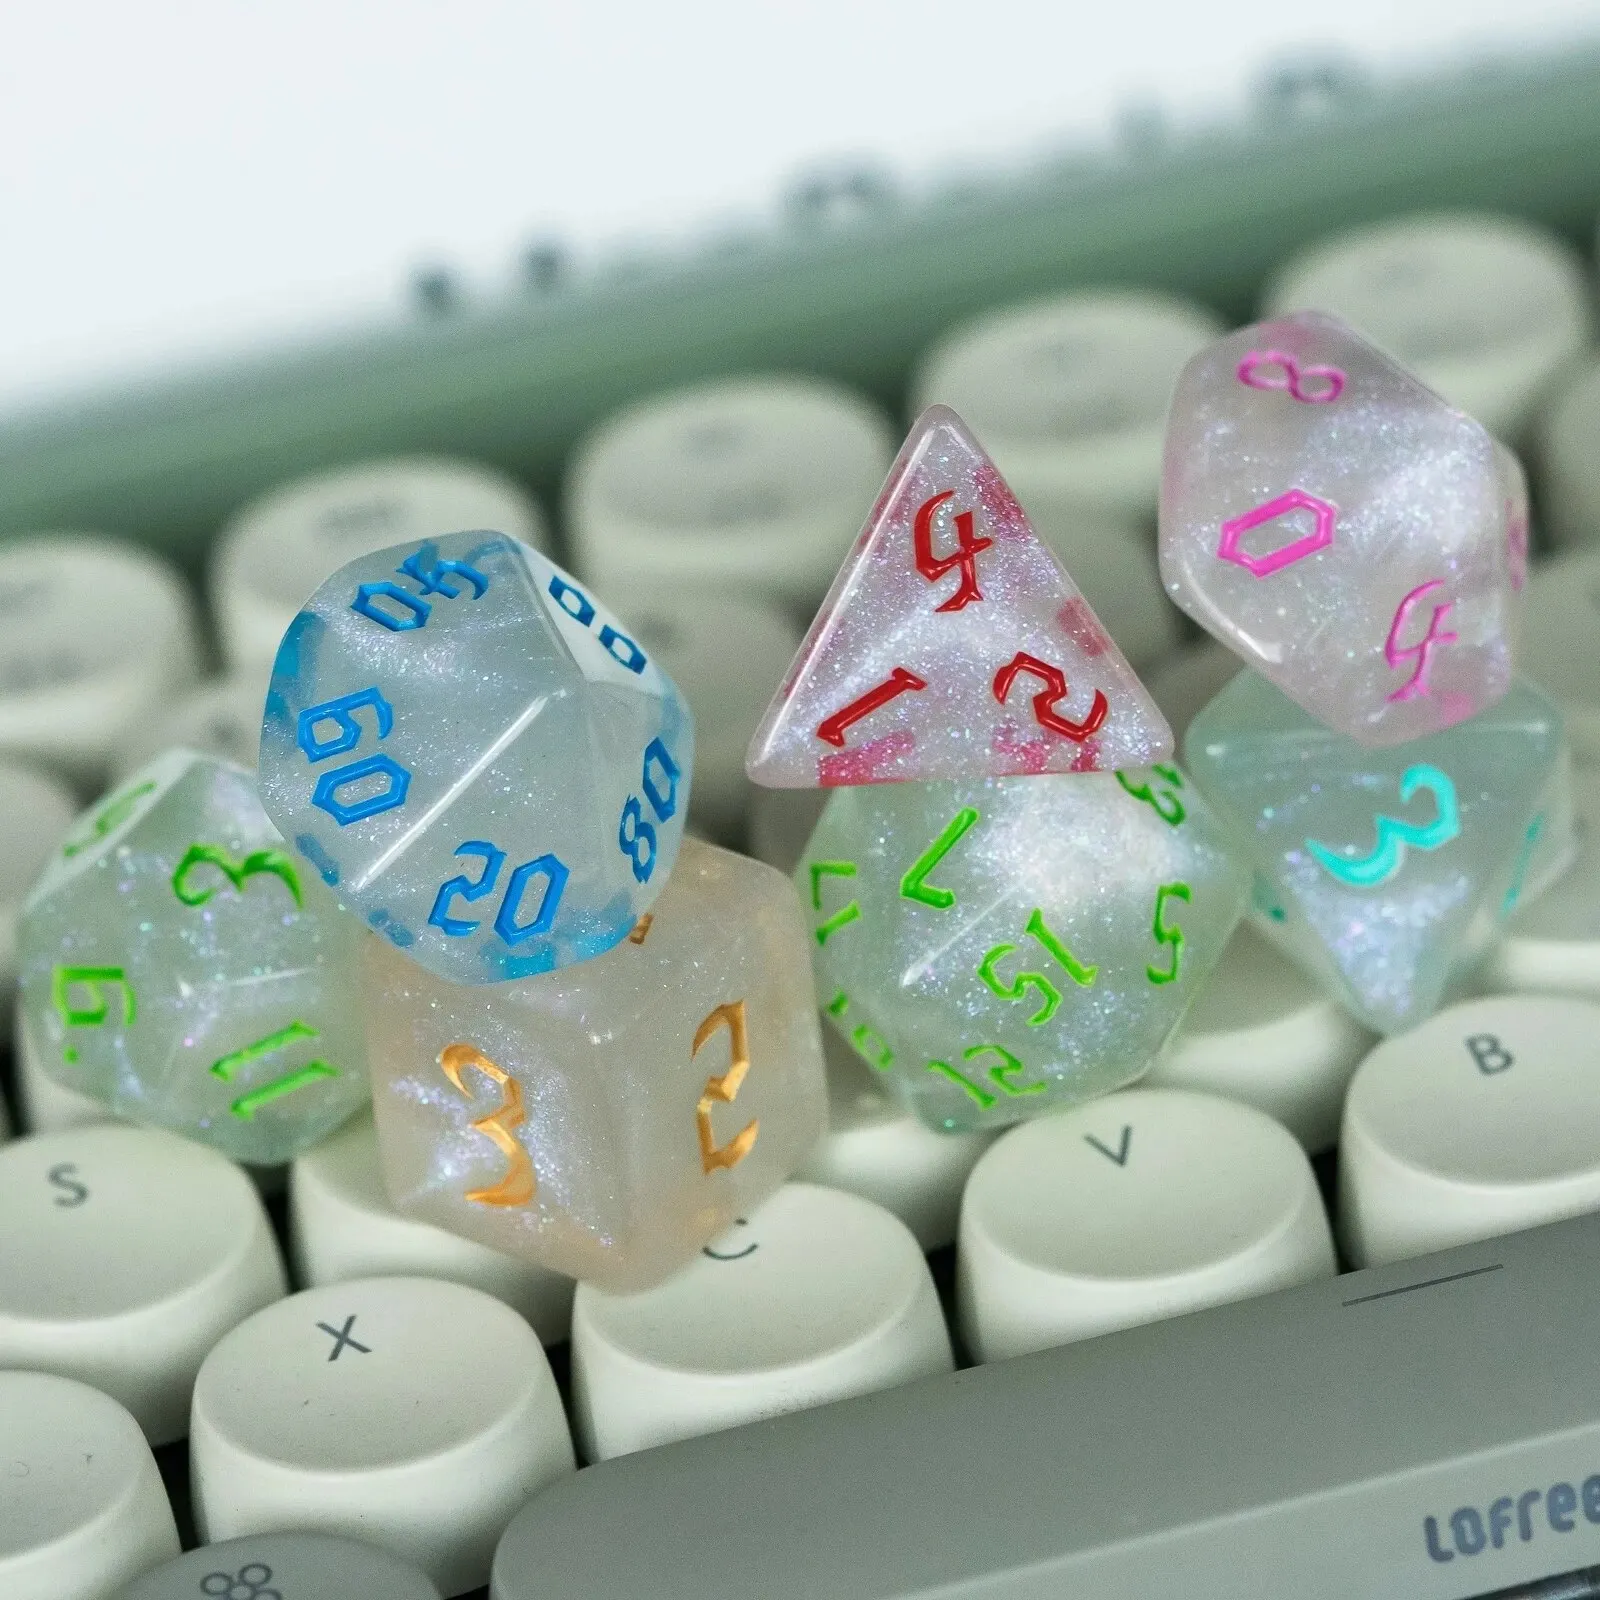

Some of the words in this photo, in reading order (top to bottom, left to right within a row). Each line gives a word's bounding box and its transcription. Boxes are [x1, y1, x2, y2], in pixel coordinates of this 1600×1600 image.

[1237, 351, 1346, 403] 8
[913, 490, 993, 613] 4
[1217, 488, 1336, 580] 0
[350, 548, 489, 632] 40
[549, 576, 647, 675] 00
[1385, 580, 1458, 703] 4
[816, 667, 927, 747] 1
[993, 651, 1108, 743] 2
[298, 687, 411, 826] 60
[619, 737, 682, 884] 80
[902, 807, 979, 910] 7
[1305, 763, 1460, 887] 3
[172, 843, 304, 910] 3
[428, 841, 570, 947] 20
[977, 908, 1099, 1027] 15
[1147, 882, 1192, 986] 5
[208, 1019, 342, 1121] 11
[691, 1000, 760, 1176] 2
[926, 1044, 1048, 1111] 12
[1465, 1032, 1515, 1077] B
[439, 1042, 537, 1208] 3
[1083, 1124, 1133, 1168] V
[47, 1162, 90, 1208] S
[315, 1314, 373, 1362] X
